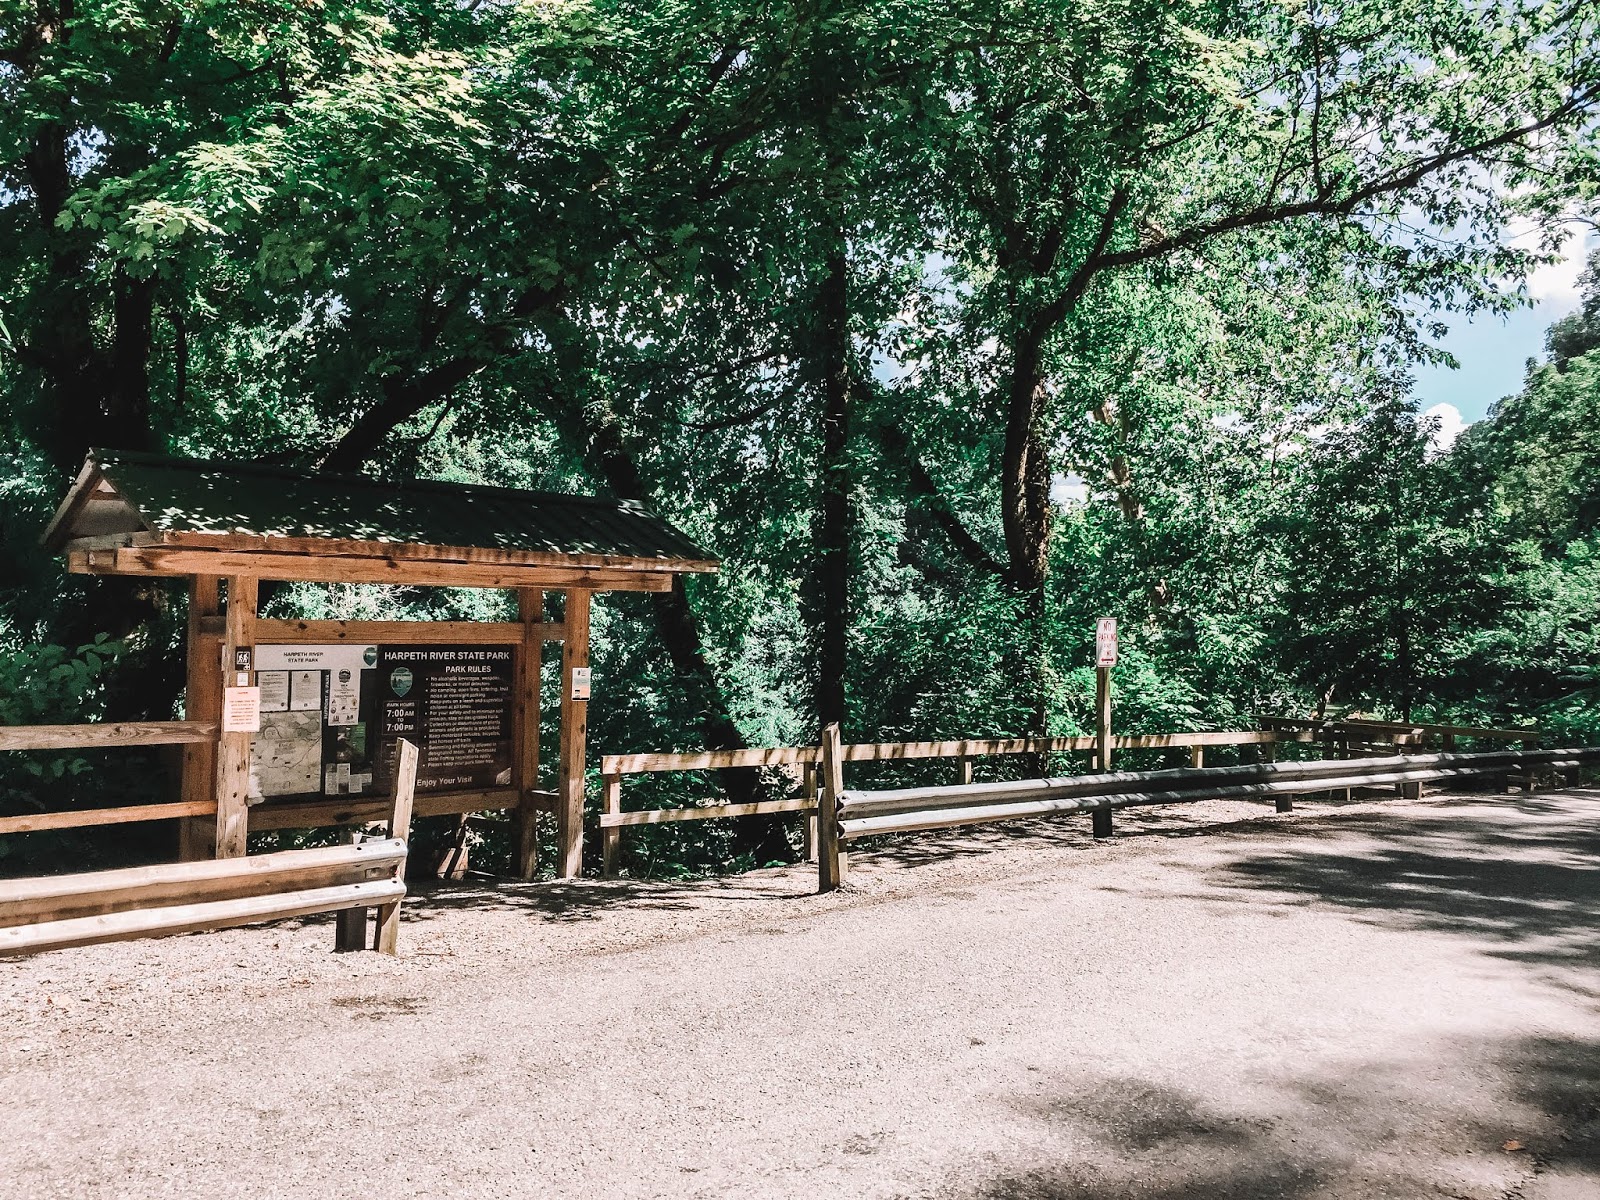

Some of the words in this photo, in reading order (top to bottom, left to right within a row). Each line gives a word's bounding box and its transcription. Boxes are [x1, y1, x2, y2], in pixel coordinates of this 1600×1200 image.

[1104, 622, 1111, 631] NO
[384, 651, 427, 661] HARPETH
[429, 651, 456, 660] RIVER
[457, 651, 485, 660] STATE
[486, 651, 510, 660] PARK
[387, 709, 404, 717] 7:00
[387, 723, 404, 731] 7:00
[416, 778, 436, 787] Enjoy
